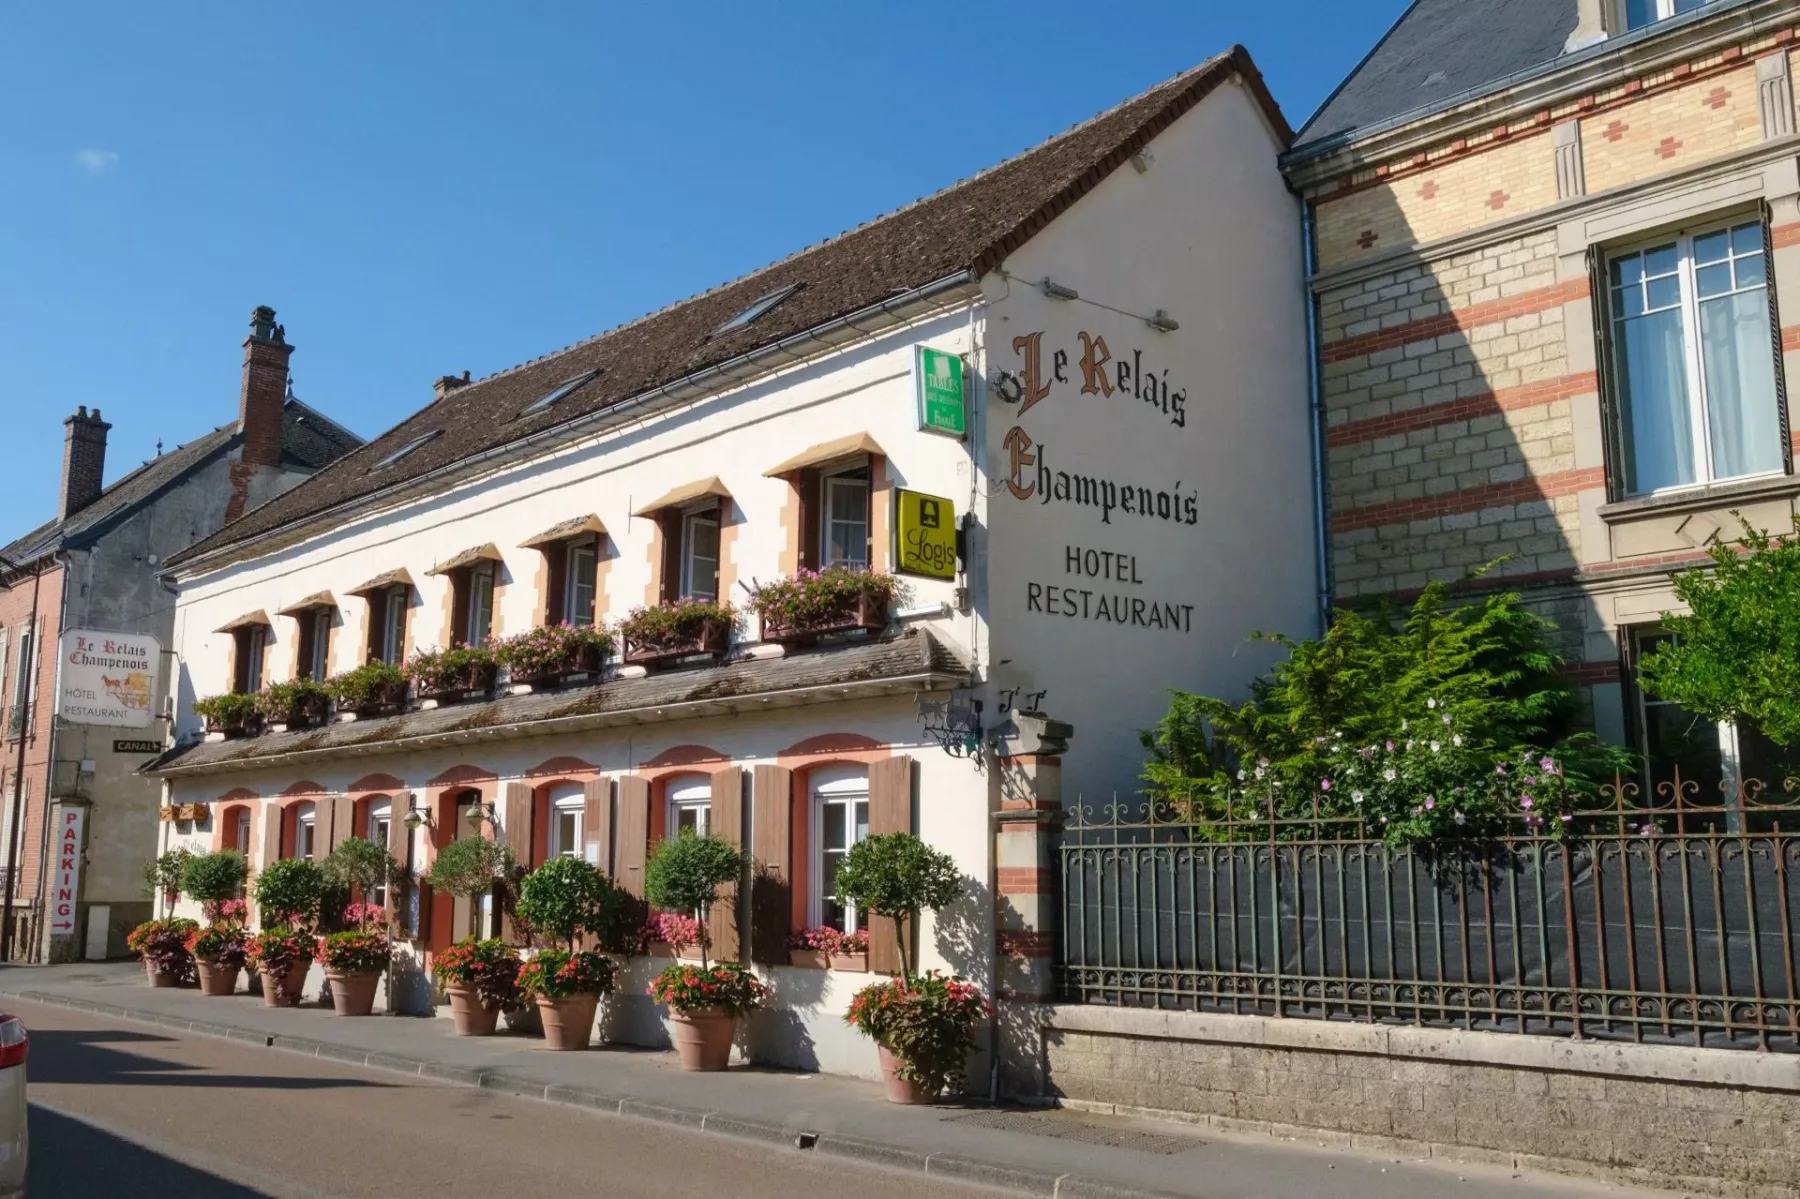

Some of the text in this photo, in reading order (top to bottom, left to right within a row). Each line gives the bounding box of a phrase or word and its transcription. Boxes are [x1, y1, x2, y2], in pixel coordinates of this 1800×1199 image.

[1012, 331, 1187, 428] Le Relais
[1002, 425, 1199, 526] Champenois
[905, 527, 956, 571] Logis
[1065, 545, 1144, 584] HOTEL
[1027, 582, 1195, 633] RESTAURANT
[68, 651, 149, 670] Champenois
[76, 636, 147, 657] Le Relais
[63, 705, 129, 719] RESTAURANT
[64, 687, 97, 700] HÔTEL
[117, 742, 160, 752] CANAL+
[57, 812, 77, 916] PARKING
